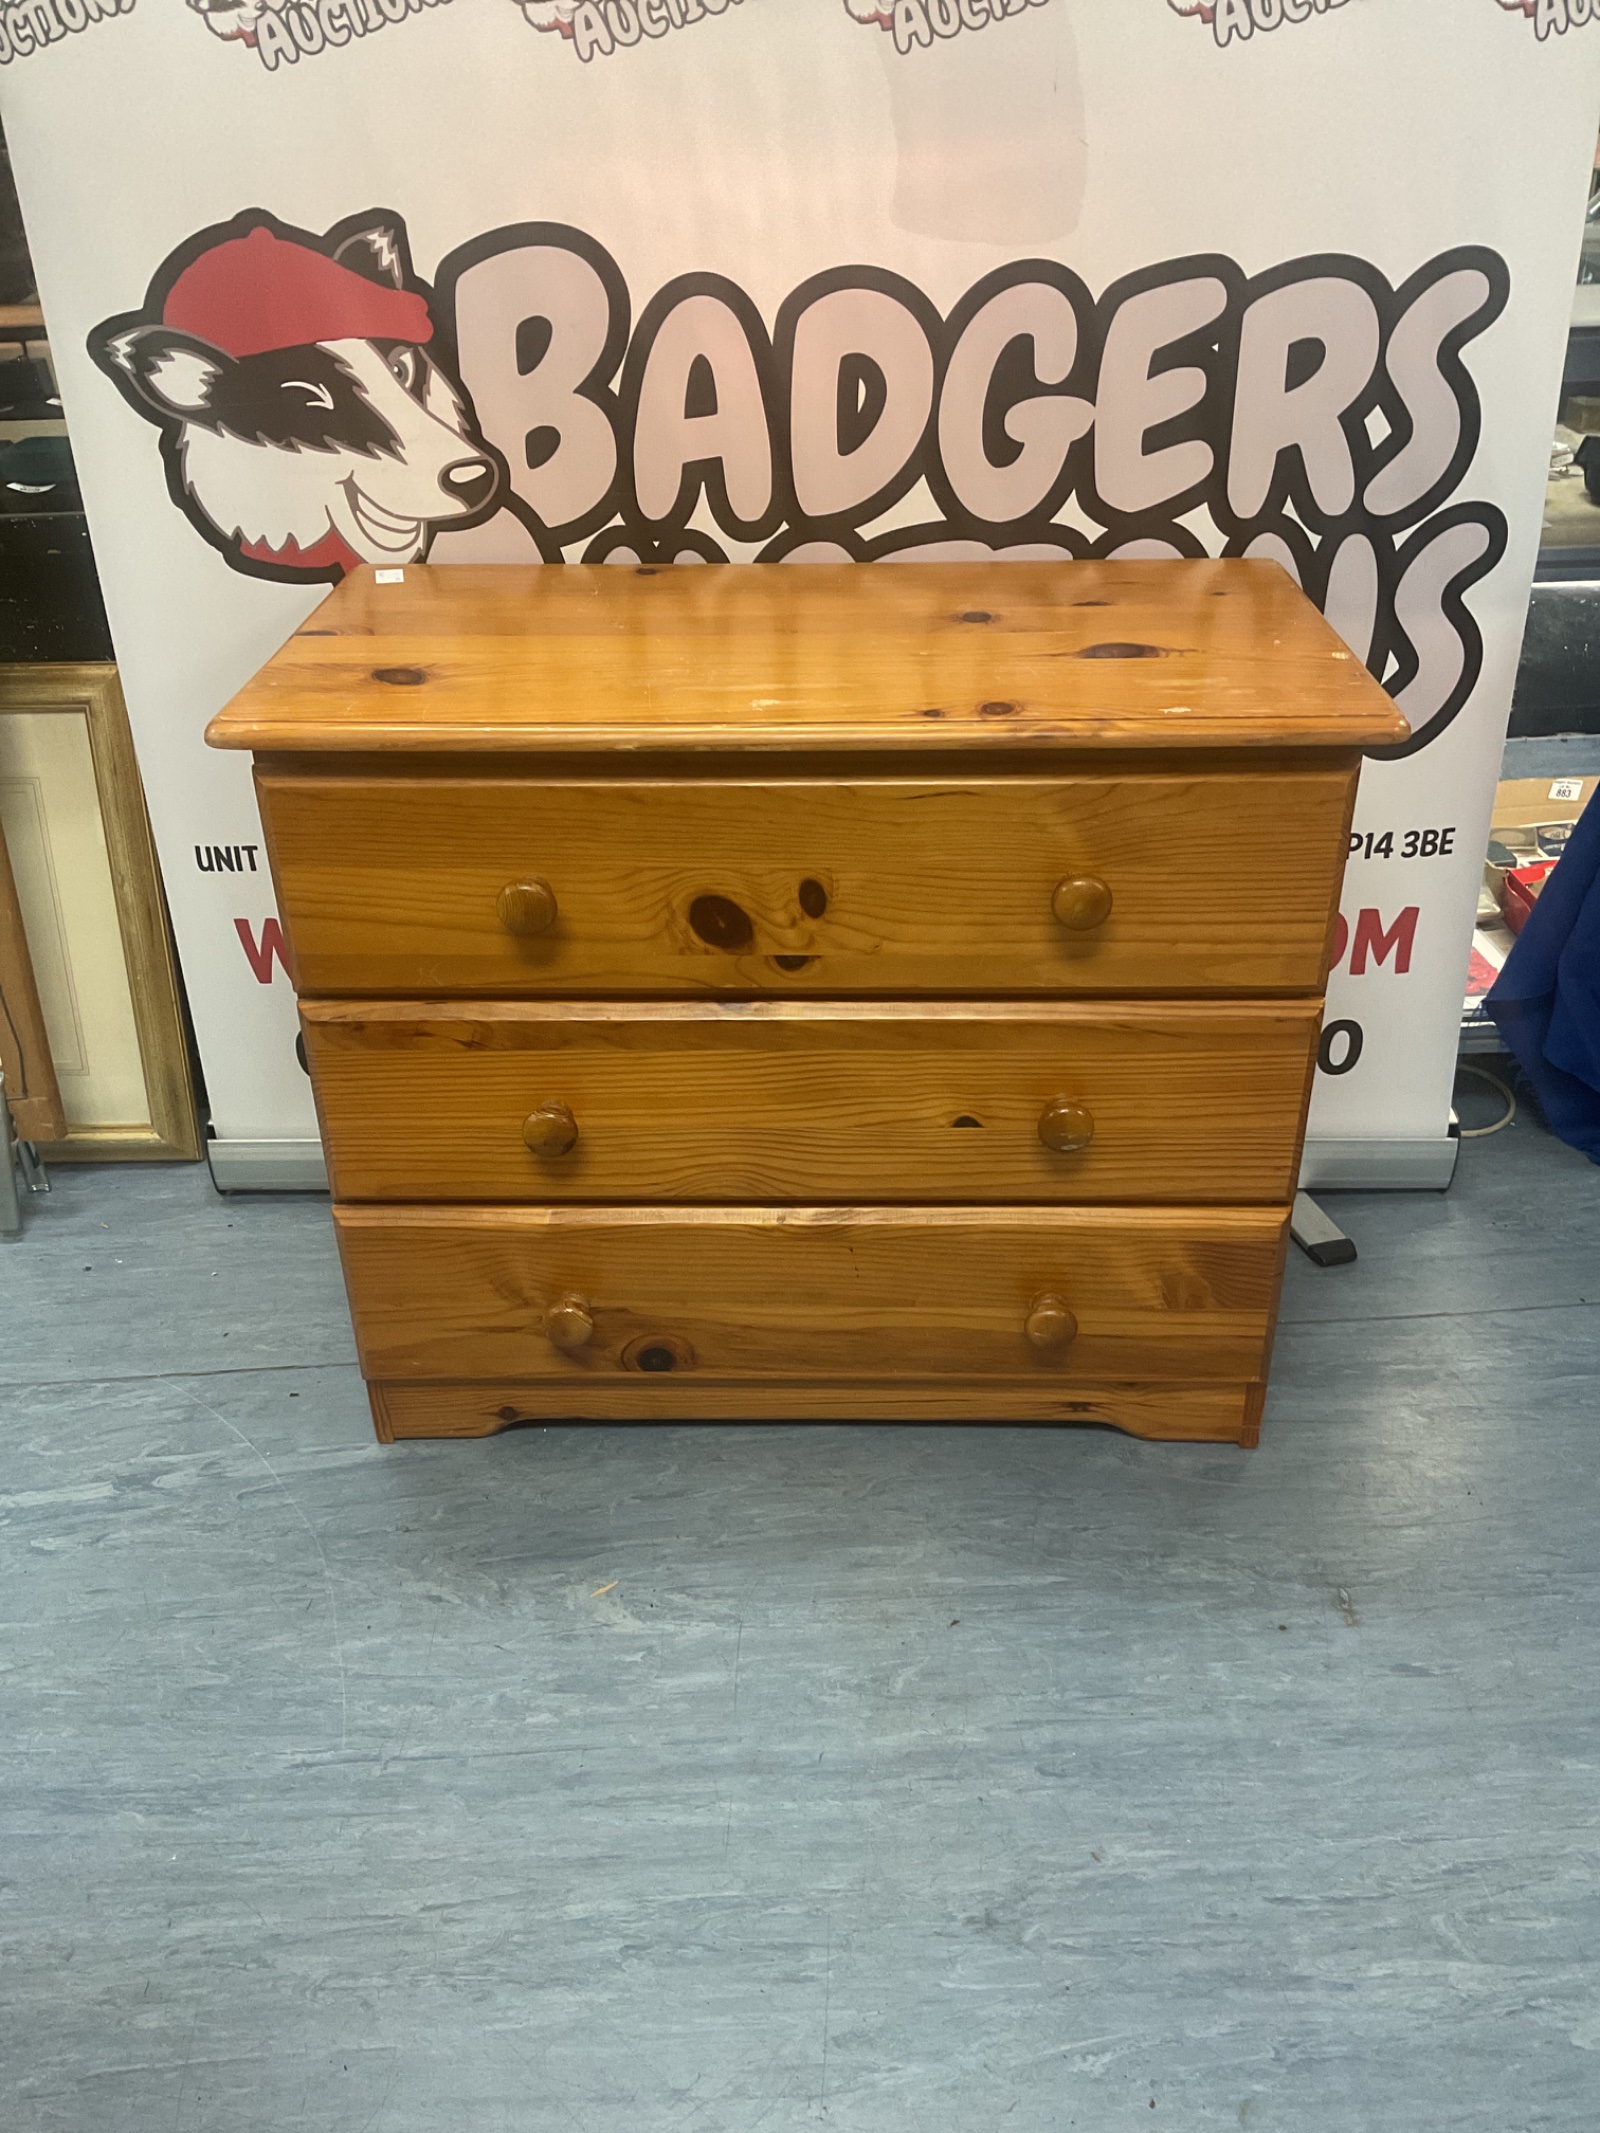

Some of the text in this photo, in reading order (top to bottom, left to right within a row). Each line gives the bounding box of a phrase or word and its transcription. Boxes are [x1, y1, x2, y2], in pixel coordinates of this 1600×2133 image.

[434, 221, 1510, 536] BADGERS
[1556, 789, 1572, 798] 883
[1400, 827, 1456, 858] 3BE
[194, 844, 258, 873] UNIT
